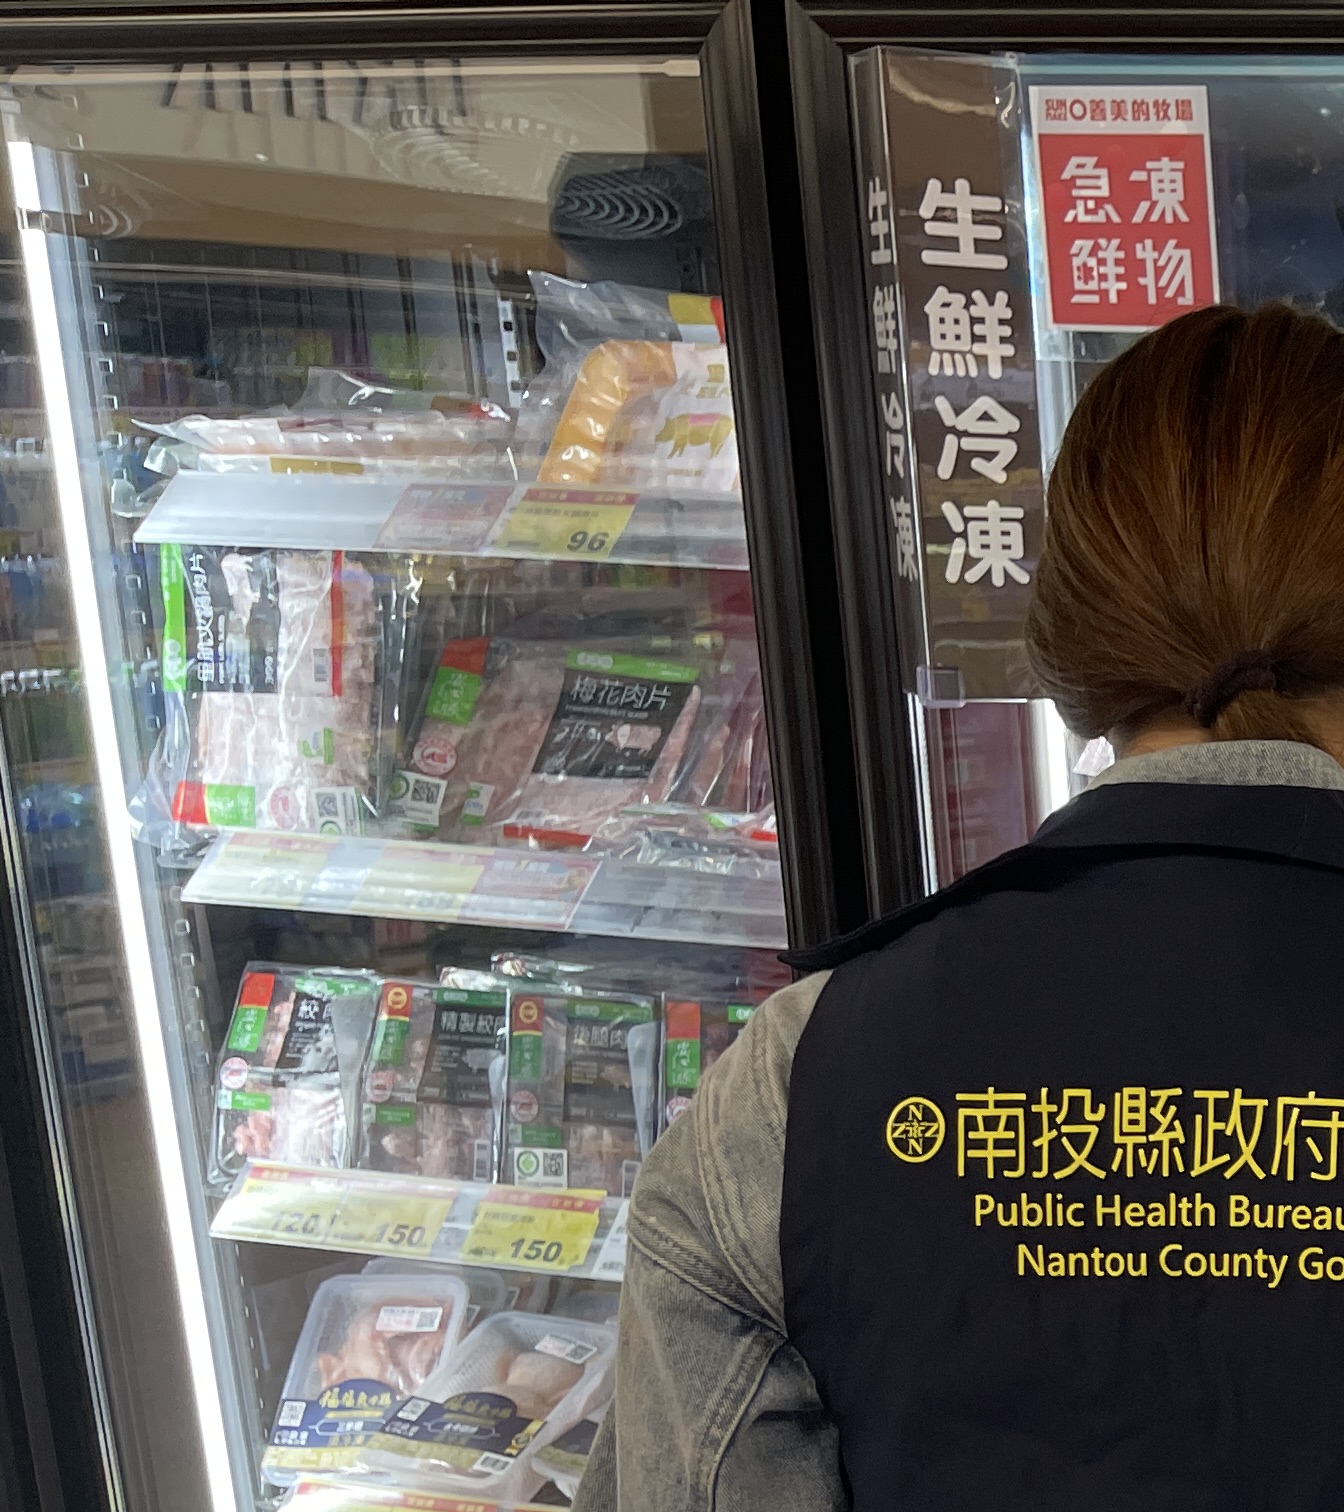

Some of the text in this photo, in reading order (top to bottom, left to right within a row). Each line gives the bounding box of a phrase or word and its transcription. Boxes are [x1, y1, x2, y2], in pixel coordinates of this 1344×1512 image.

[1060, 155, 1191, 224] 急凍
[1069, 238, 1194, 305] 鮮物
[918, 176, 1031, 588] 生鮮冷凍
[566, 530, 610, 551] 96
[974, 1193, 1087, 1229] Public
[1094, 1193, 1218, 1229] Health
[374, 1221, 427, 1248] 150
[508, 1237, 563, 1263] 150
[1016, 1243, 1148, 1279] Nantou
[1158, 1243, 1288, 1290] County
